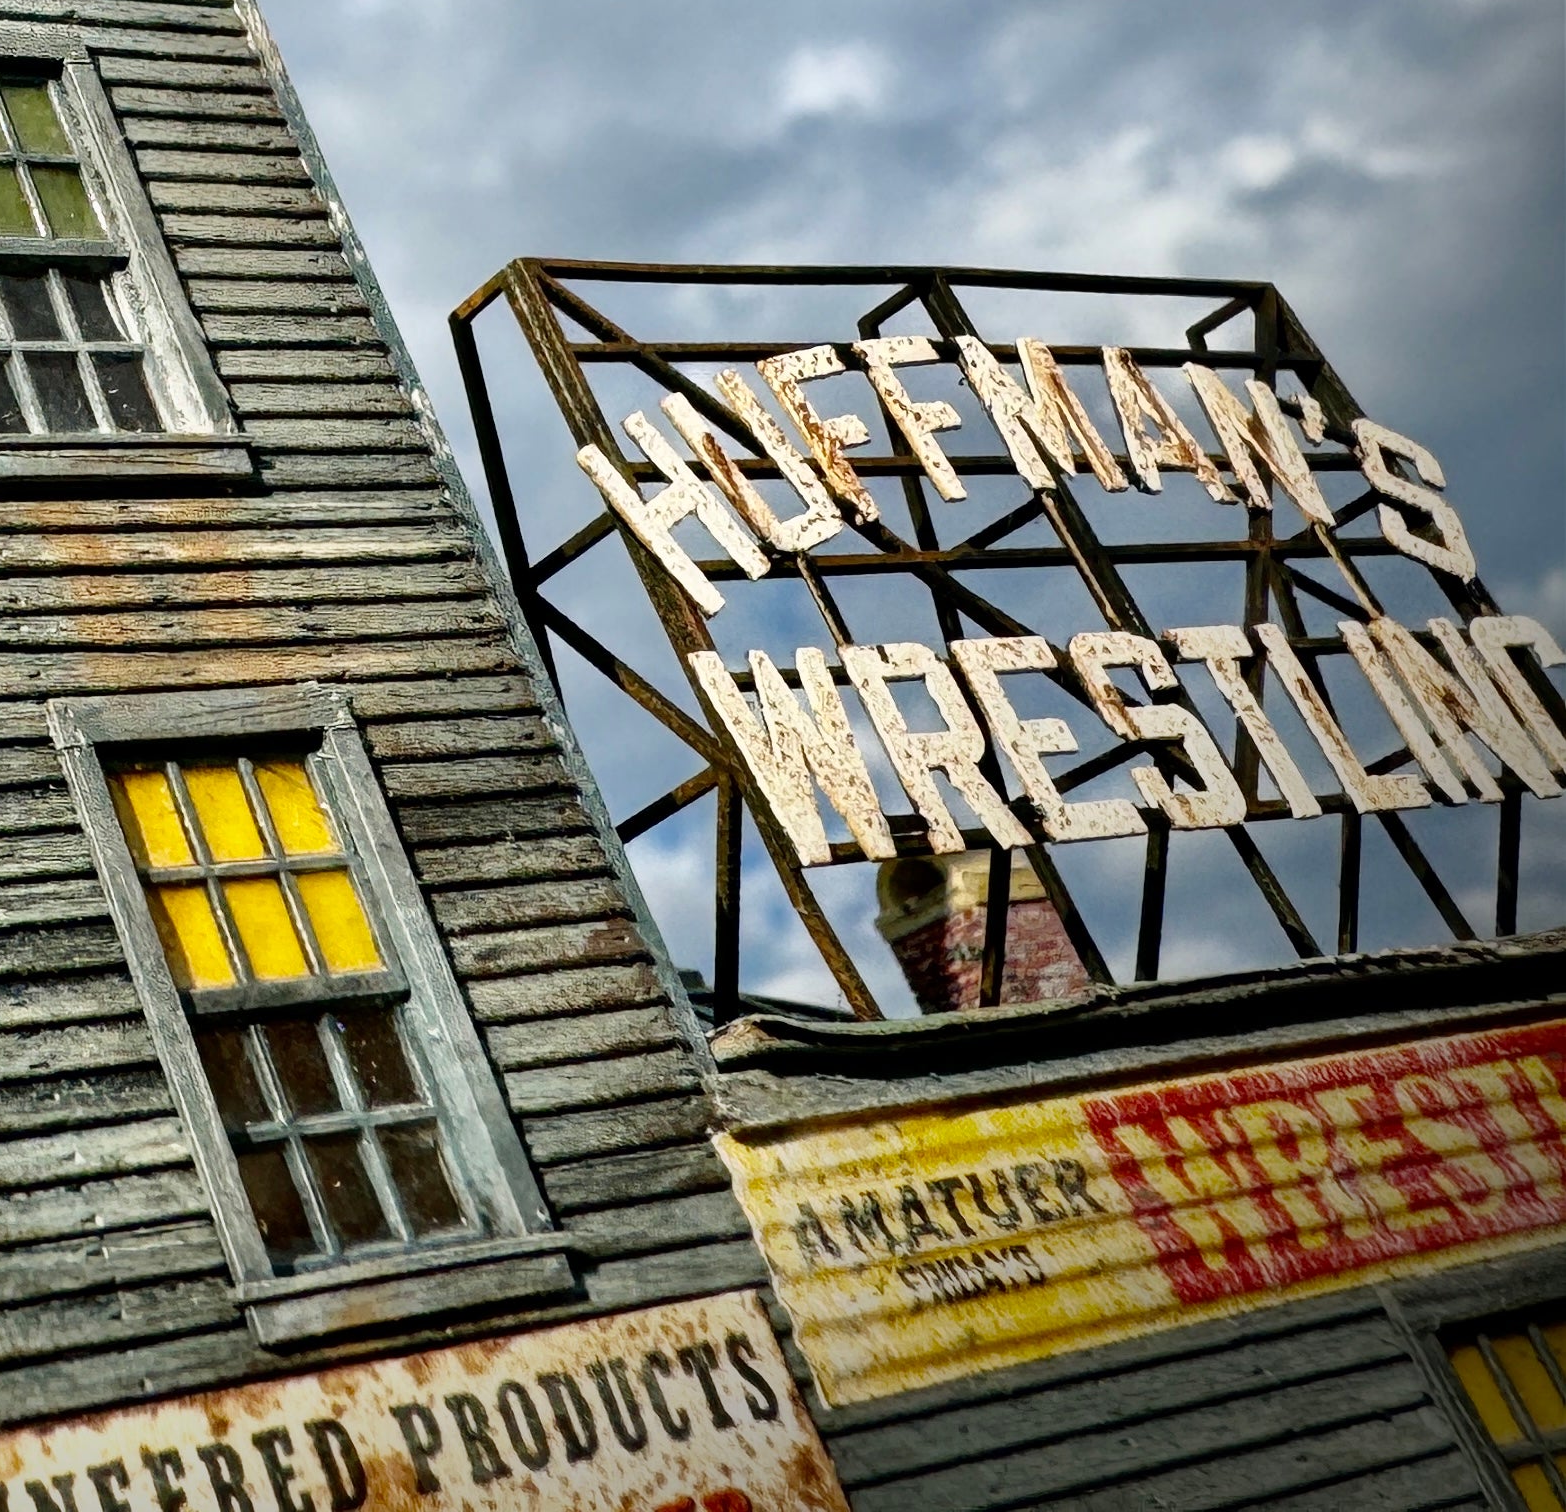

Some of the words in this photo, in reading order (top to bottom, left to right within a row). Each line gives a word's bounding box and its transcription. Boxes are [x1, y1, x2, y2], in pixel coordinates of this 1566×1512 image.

[576, 335, 1476, 617] HUFFMAN'S
[791, 1158, 1108, 1270] AMATUER
[390, 1330, 780, 1495] PRODUCTS
